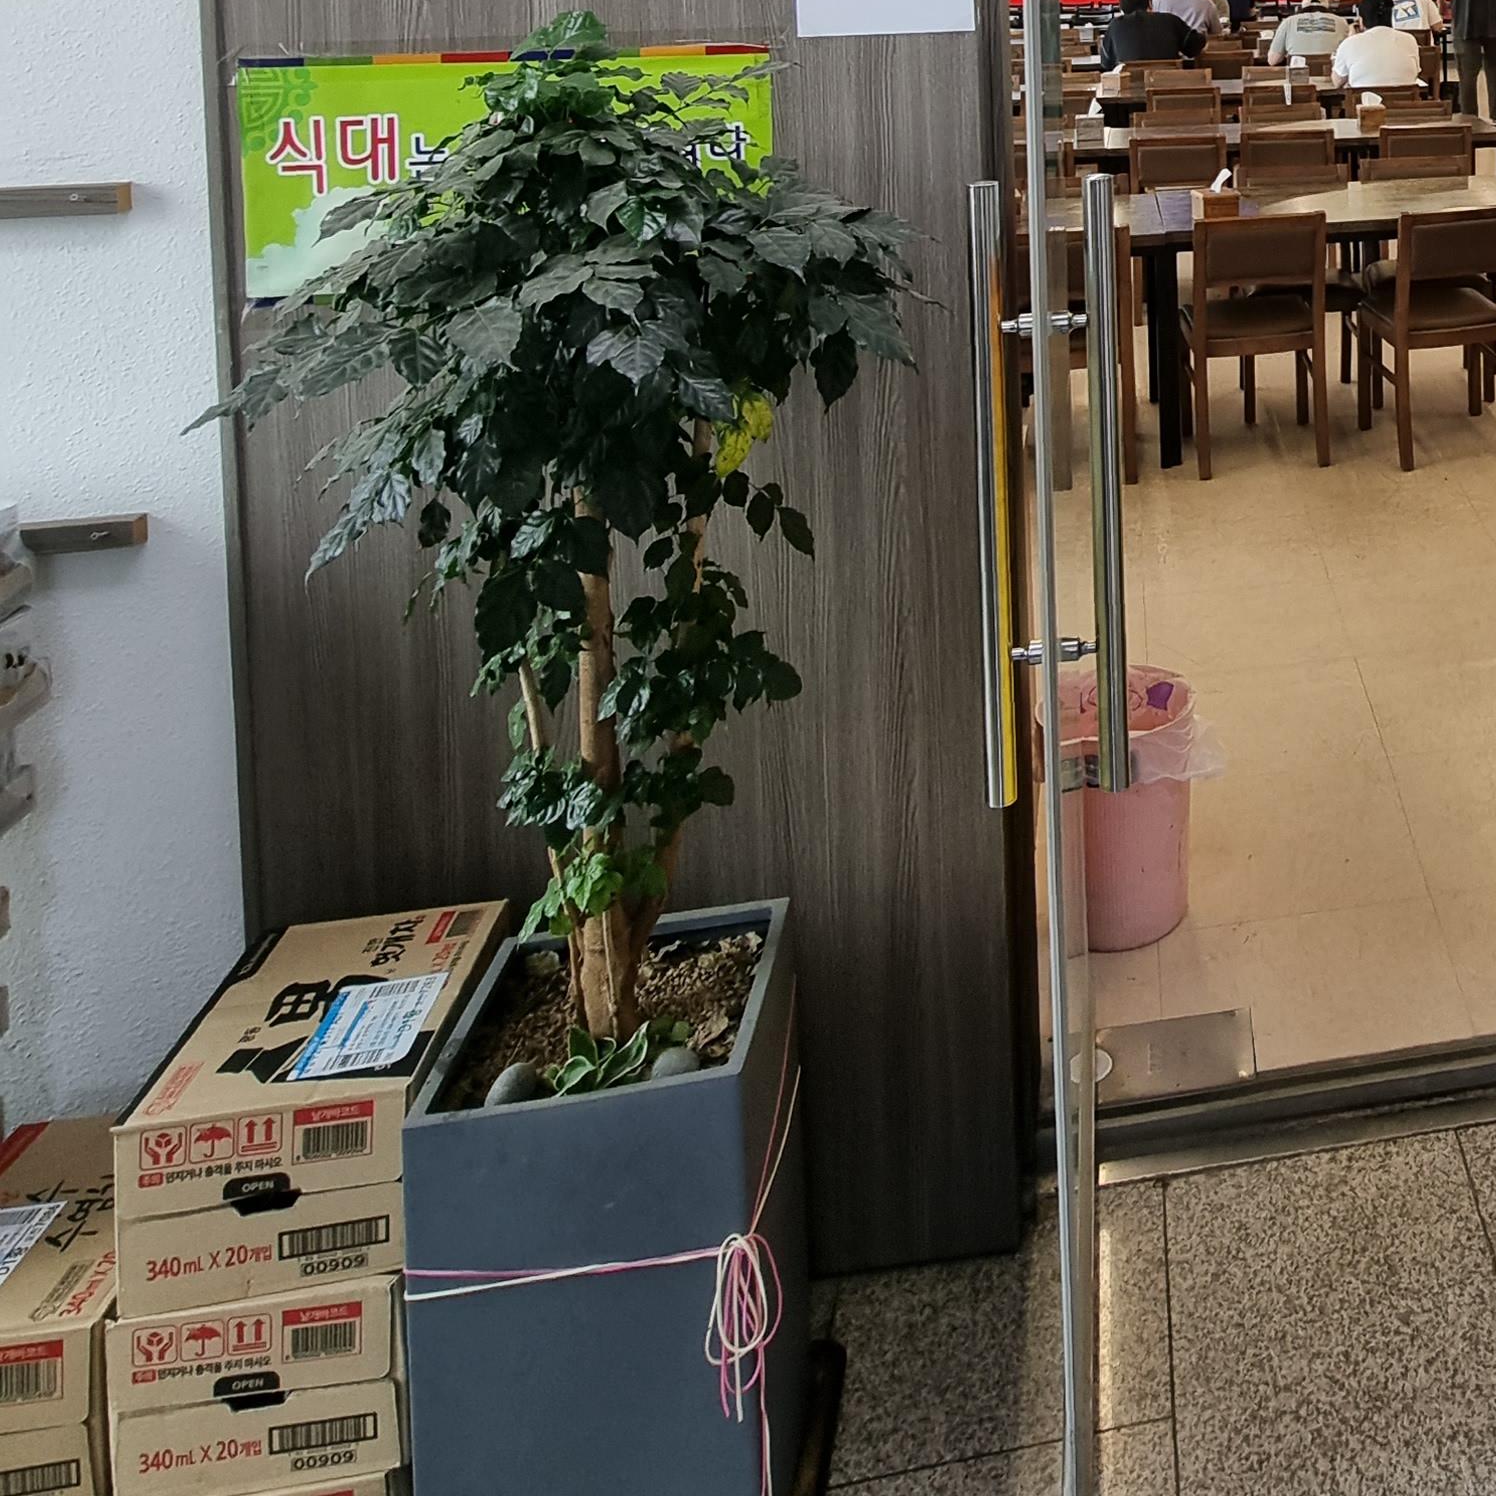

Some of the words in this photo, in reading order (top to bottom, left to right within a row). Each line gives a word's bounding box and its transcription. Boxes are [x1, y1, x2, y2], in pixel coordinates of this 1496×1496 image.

[241, 1181, 275, 1194] OPEN
[303, 1255, 366, 1276] 00909
[231, 1377, 265, 1391] OPEN
[292, 1452, 355, 1471] 00909
